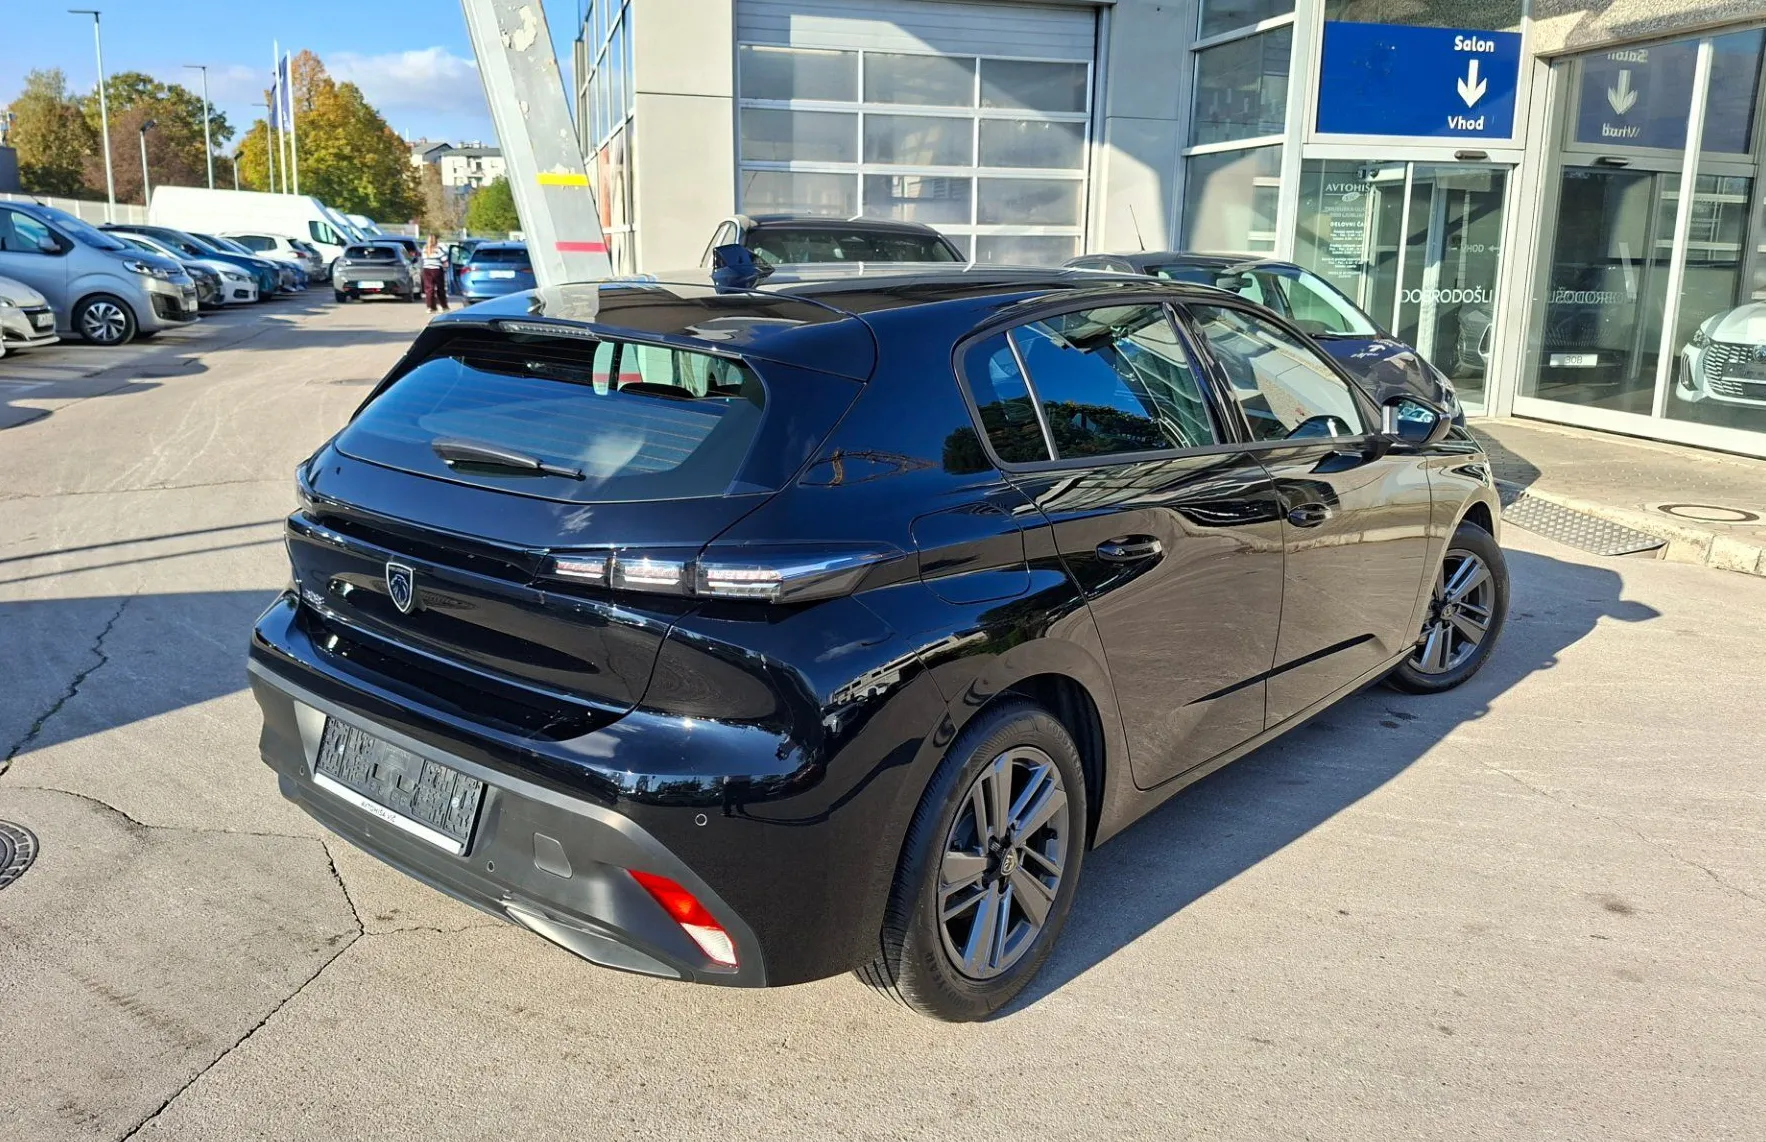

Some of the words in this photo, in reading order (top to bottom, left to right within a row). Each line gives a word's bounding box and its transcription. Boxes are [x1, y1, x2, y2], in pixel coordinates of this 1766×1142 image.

[1454, 35, 1495, 52] Salon
[1447, 115, 1485, 131] Vhod
[1325, 183, 1370, 193] AVTOHIS
[1401, 285, 1493, 304] DOBRODOŠLI
